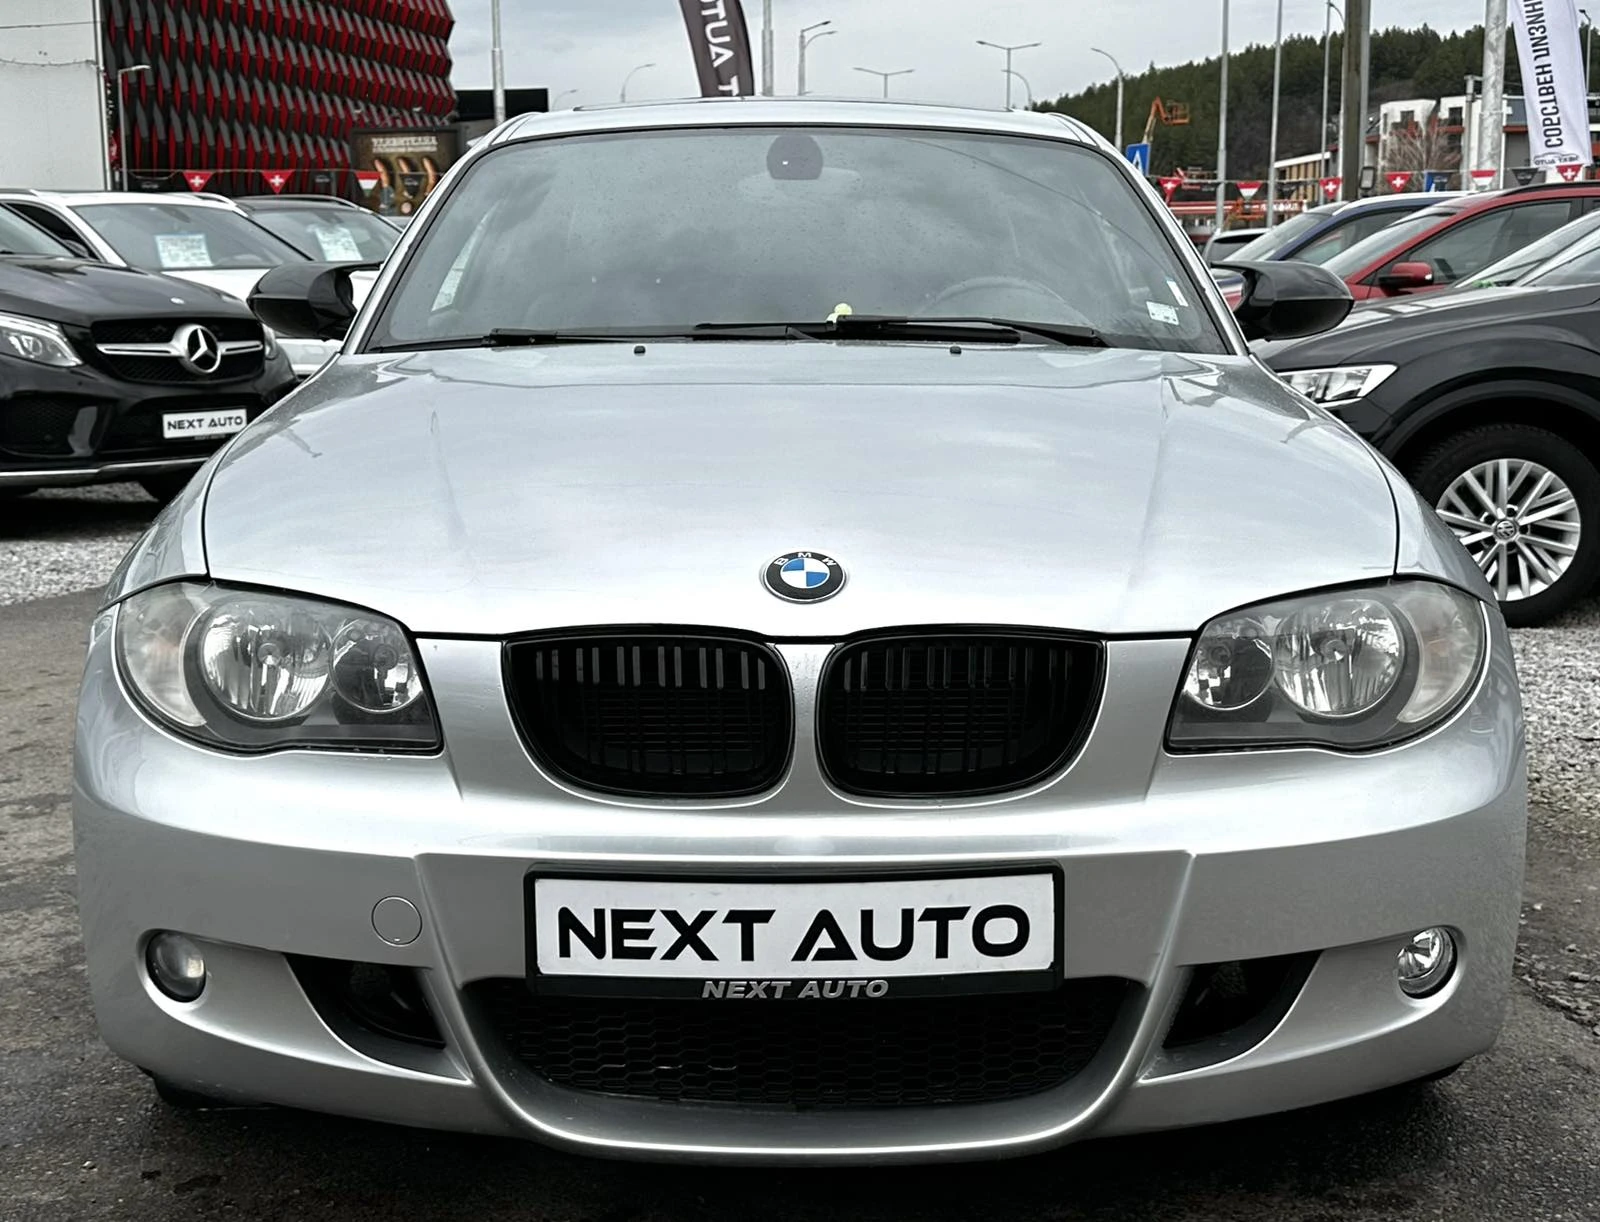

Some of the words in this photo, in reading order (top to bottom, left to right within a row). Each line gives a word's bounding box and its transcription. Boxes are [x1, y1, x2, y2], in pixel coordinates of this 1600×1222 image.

[167, 418, 205, 430] NEXT
[208, 416, 243, 428] AUTO
[773, 552, 837, 566] BMW
[558, 906, 776, 962] NEXT
[790, 904, 1030, 962] AUTO
[702, 980, 792, 999] NEXT
[798, 979, 889, 998] AUTO
